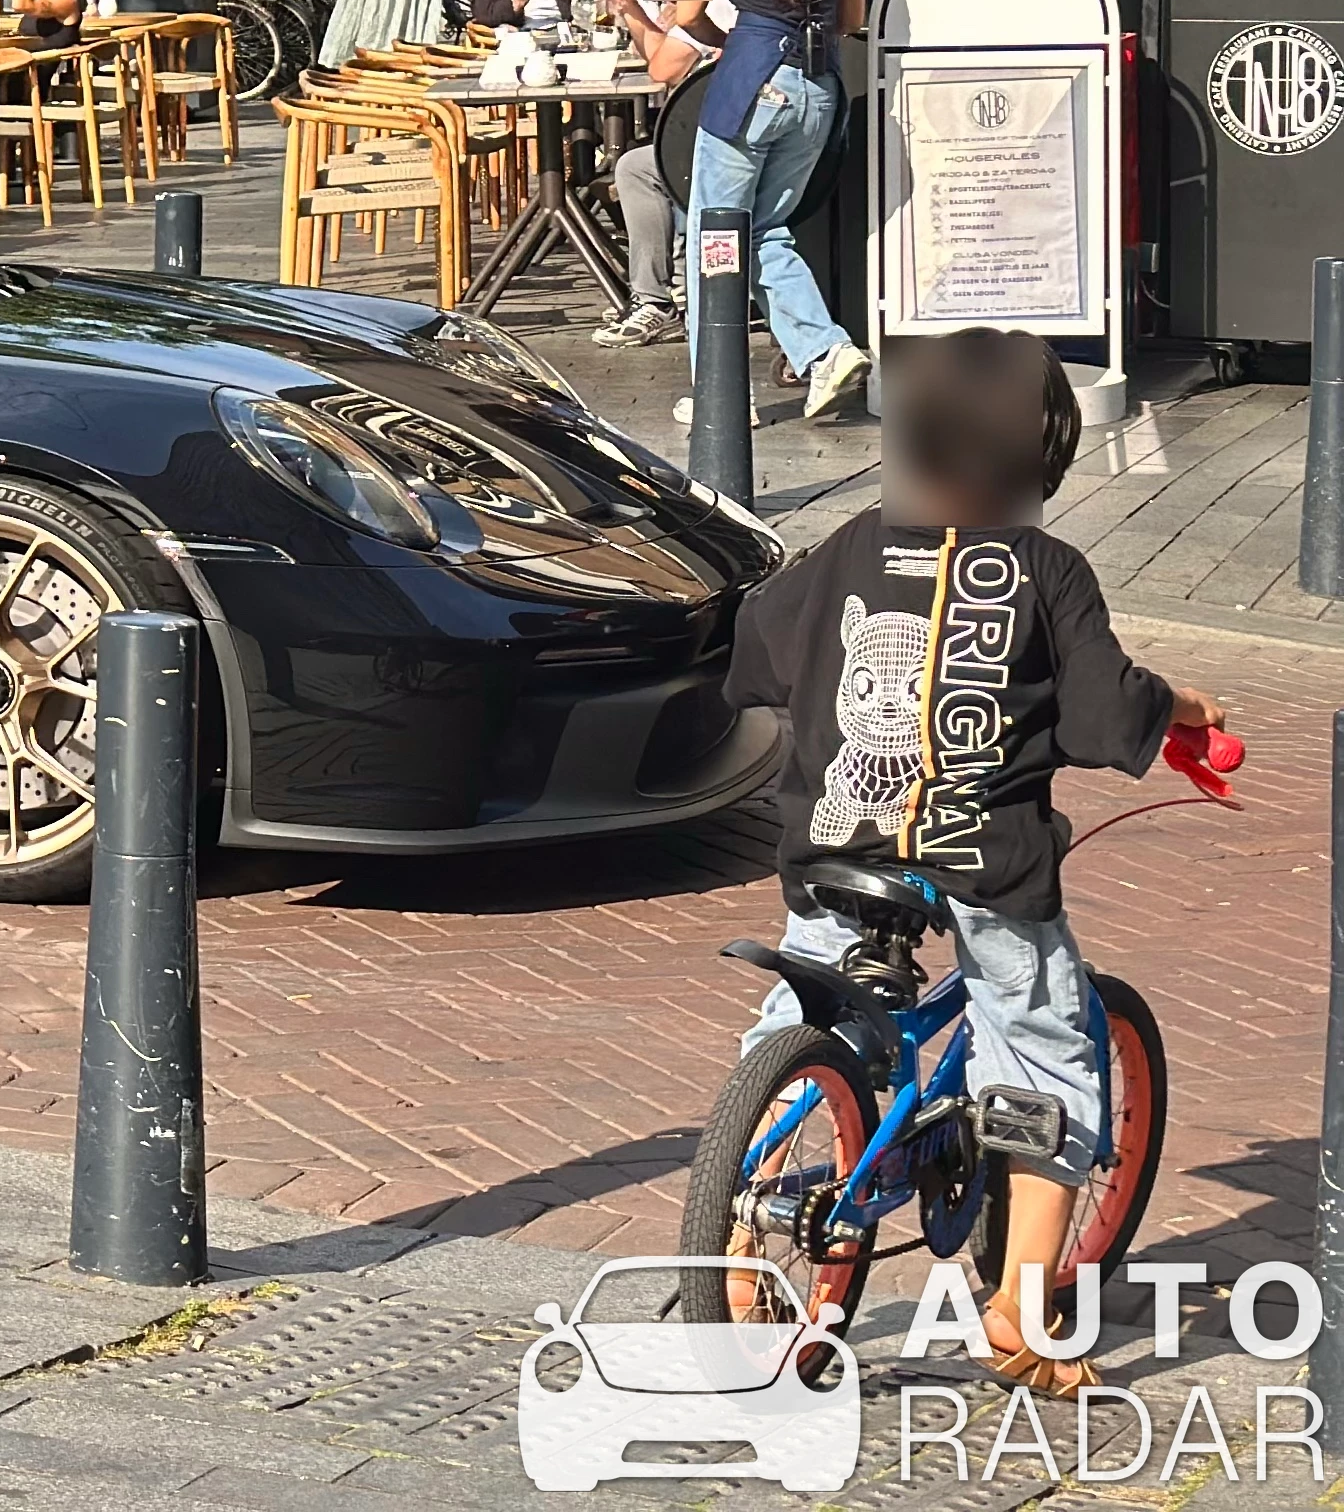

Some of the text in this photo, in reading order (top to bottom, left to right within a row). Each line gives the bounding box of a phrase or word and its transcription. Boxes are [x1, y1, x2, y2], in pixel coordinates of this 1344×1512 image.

[1214, 27, 1271, 75] RESTAURANT
[1287, 28, 1337, 65] CATERING
[1219, 114, 1269, 150] CATERING
[944, 152, 1041, 163] HOUSERULES
